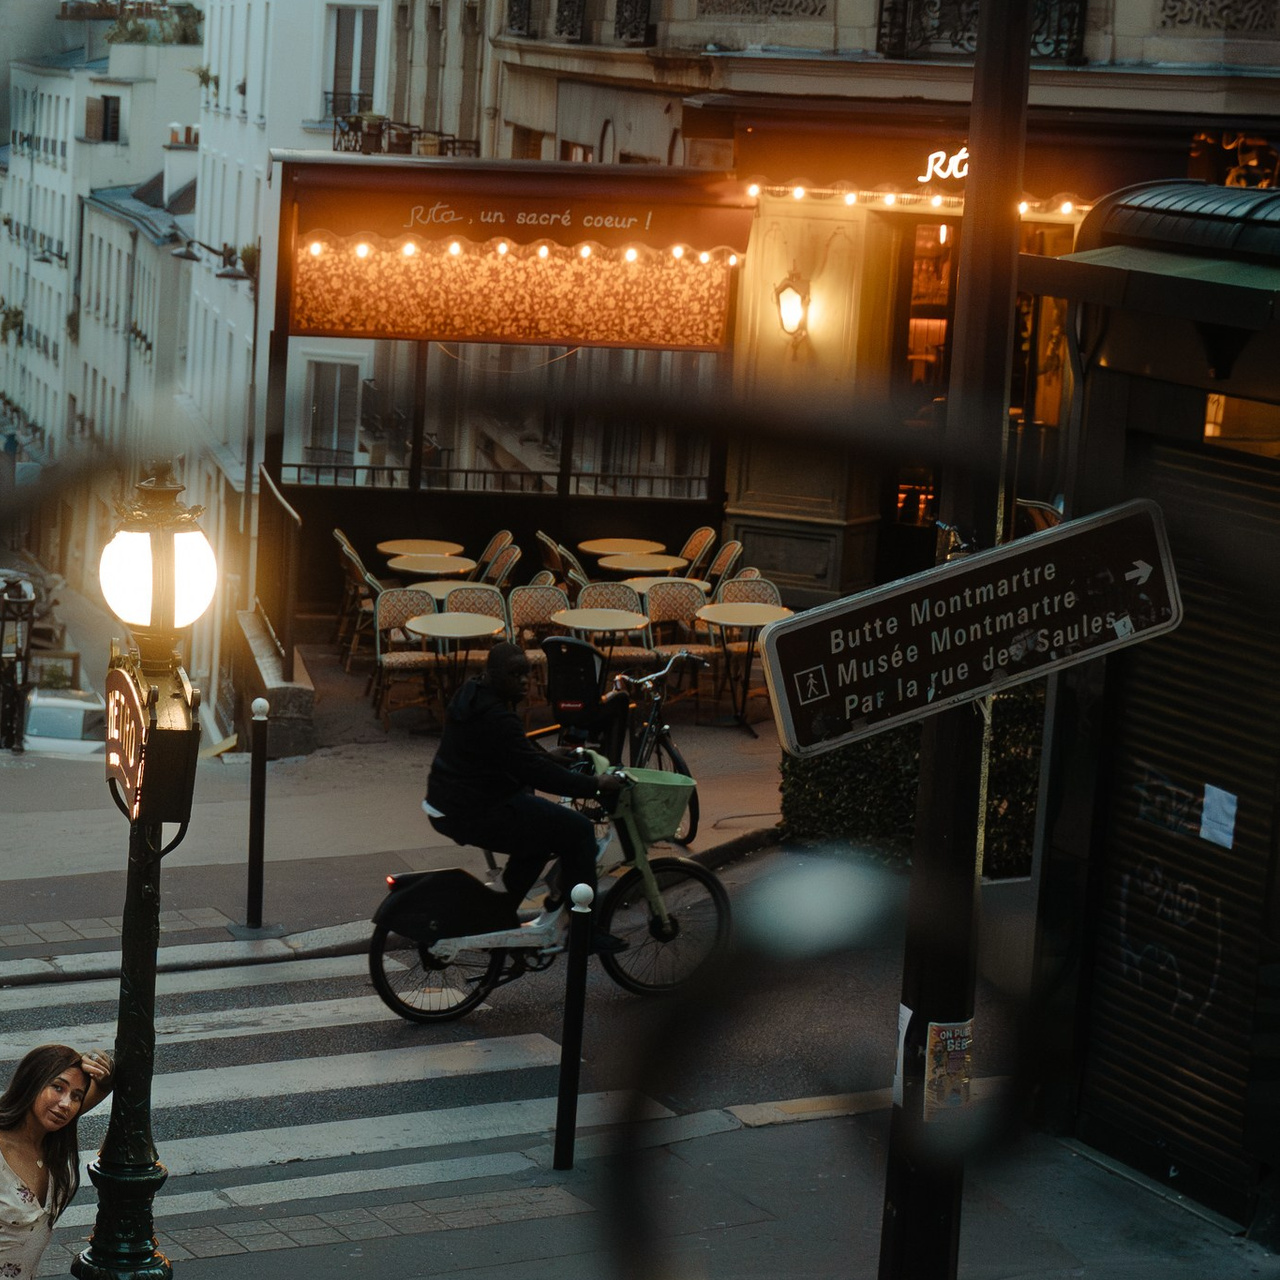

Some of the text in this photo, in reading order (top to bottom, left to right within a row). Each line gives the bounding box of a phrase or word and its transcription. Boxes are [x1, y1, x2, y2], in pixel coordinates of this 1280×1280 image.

[480, 209, 506, 224] un
[516, 209, 572, 227] sacré
[582, 211, 638, 229] coeur
[829, 561, 1057, 655] Butte Montmartre
[836, 590, 1077, 688] Musée Montmartre
[844, 687, 886, 720] Par
[897, 677, 918, 701] la
[927, 660, 969, 694] rue
[1035, 609, 1117, 653] Saules
